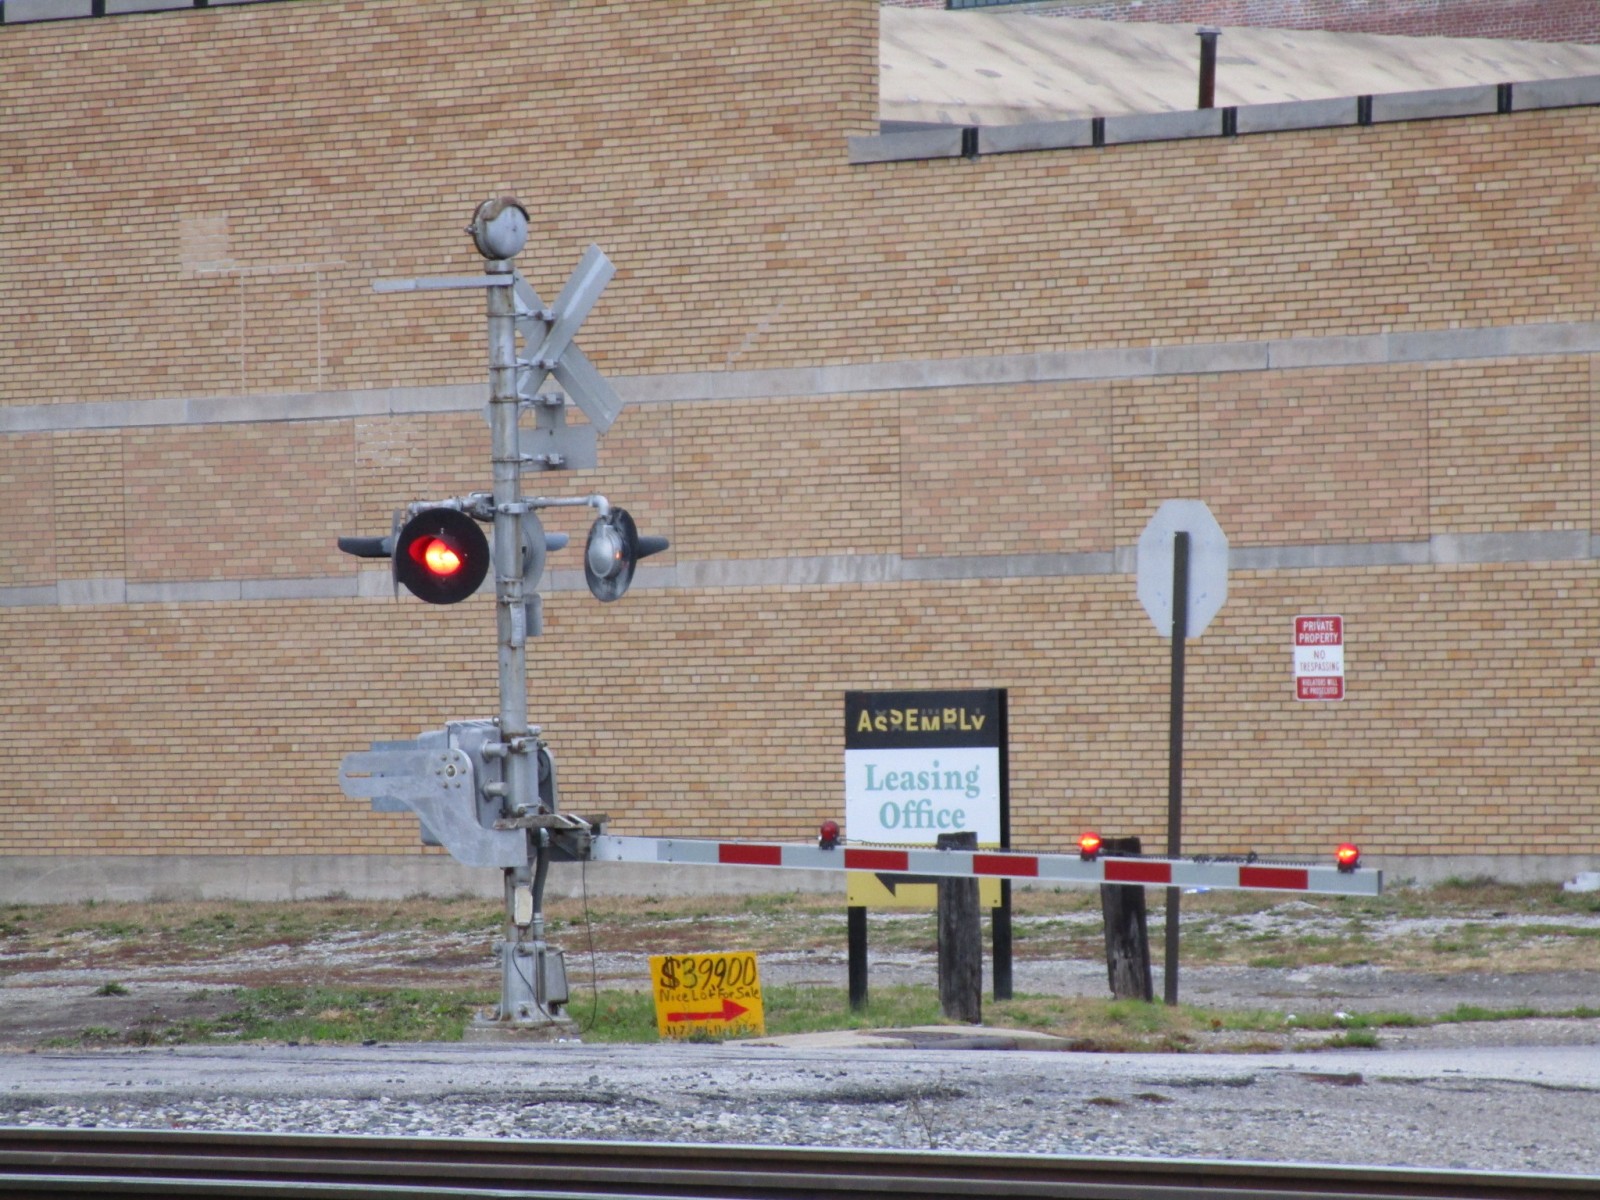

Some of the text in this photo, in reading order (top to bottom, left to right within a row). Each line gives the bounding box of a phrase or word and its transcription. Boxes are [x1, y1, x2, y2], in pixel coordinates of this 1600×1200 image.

[1303, 620, 1335, 632] PRIVATE
[1299, 632, 1339, 643] PROPERTY
[1313, 650, 1326, 660] NO
[1299, 662, 1340, 672] TRESPASSING
[857, 707, 986, 733] ASSEMBLY
[864, 760, 981, 799] Leasing
[879, 798, 966, 830] Office
[660, 956, 757, 990] $39900
[659, 988, 690, 1003] Nice
[717, 987, 735, 999] For
[736, 986, 761, 1000] Sale
